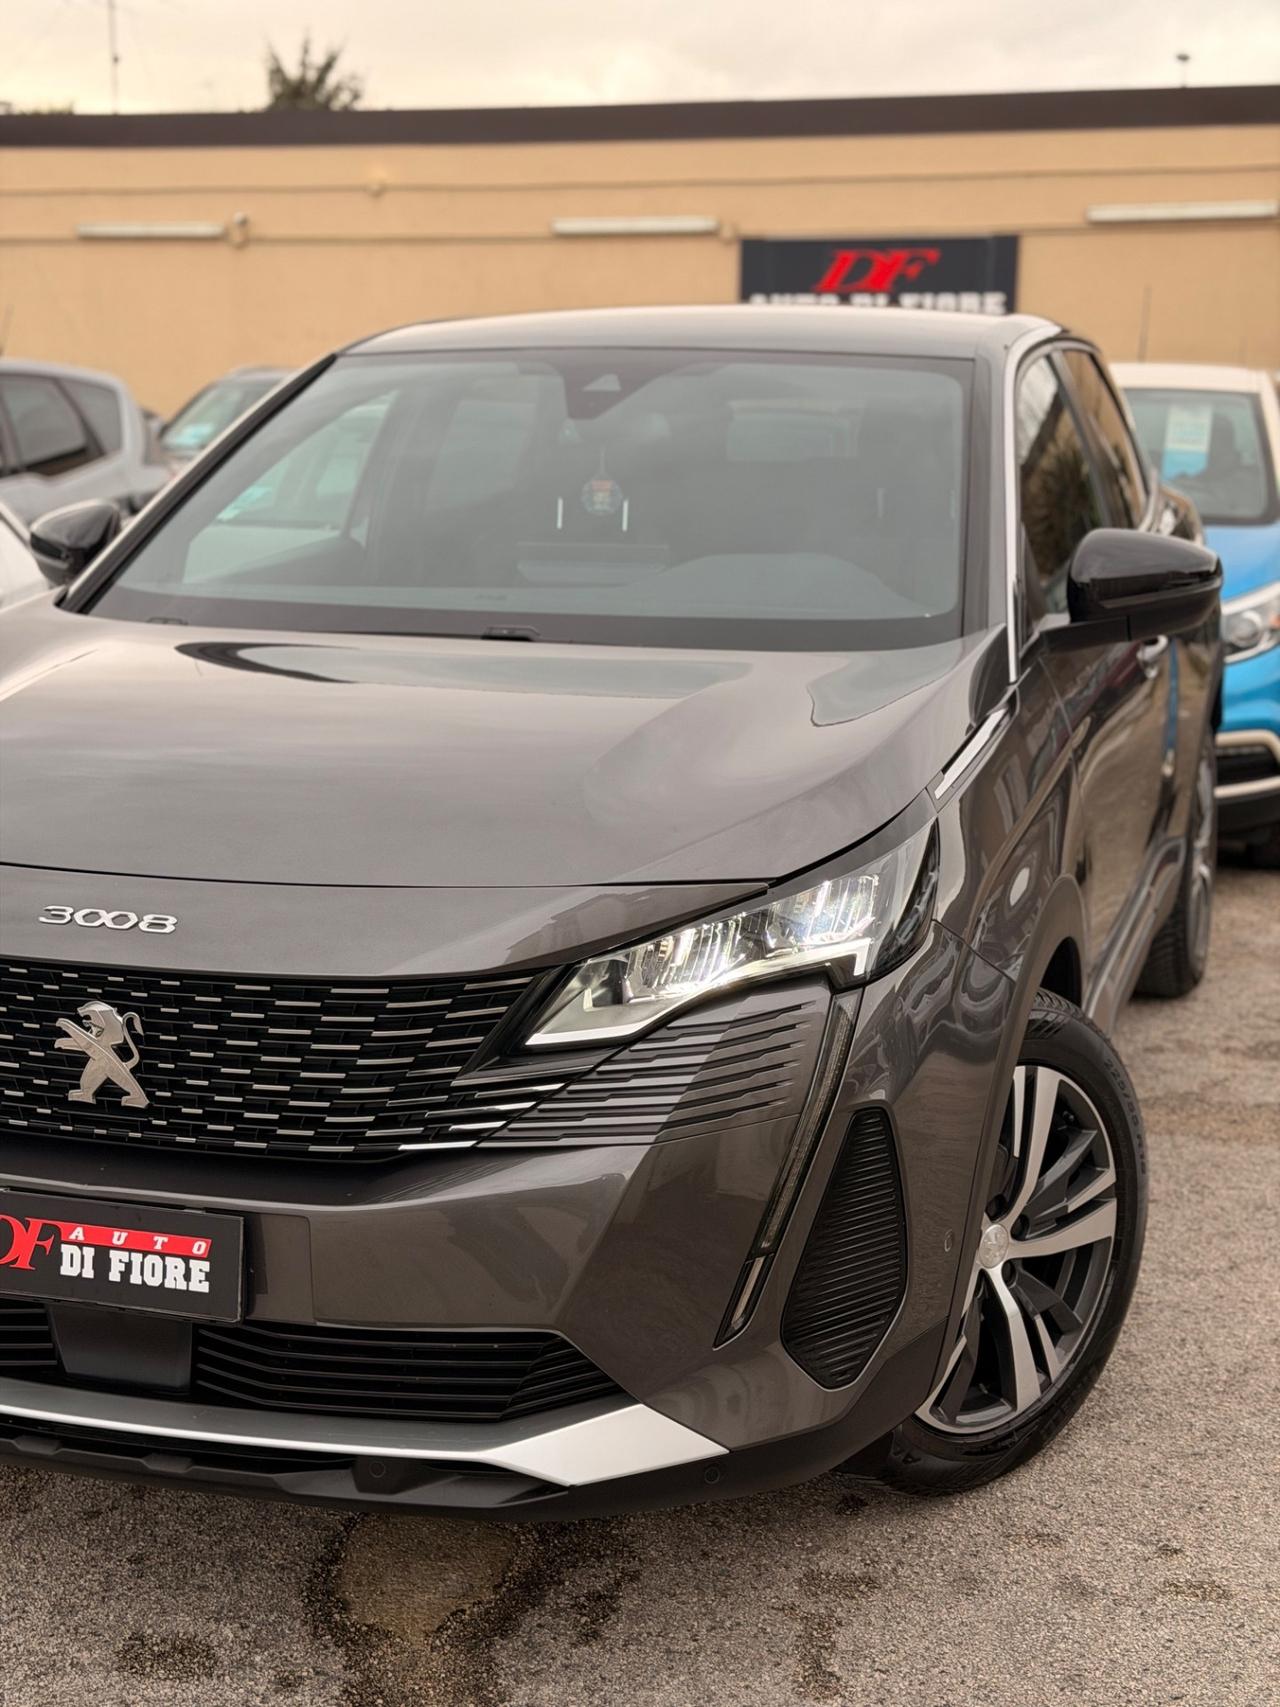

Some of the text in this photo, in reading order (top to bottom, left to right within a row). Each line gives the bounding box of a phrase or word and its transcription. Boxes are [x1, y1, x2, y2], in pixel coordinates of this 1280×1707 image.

[812, 248, 941, 293] DF
[38, 905, 178, 934] 3008
[68, 1226, 207, 1255] AUTO
[60, 1243, 211, 1294] DI FIORE
